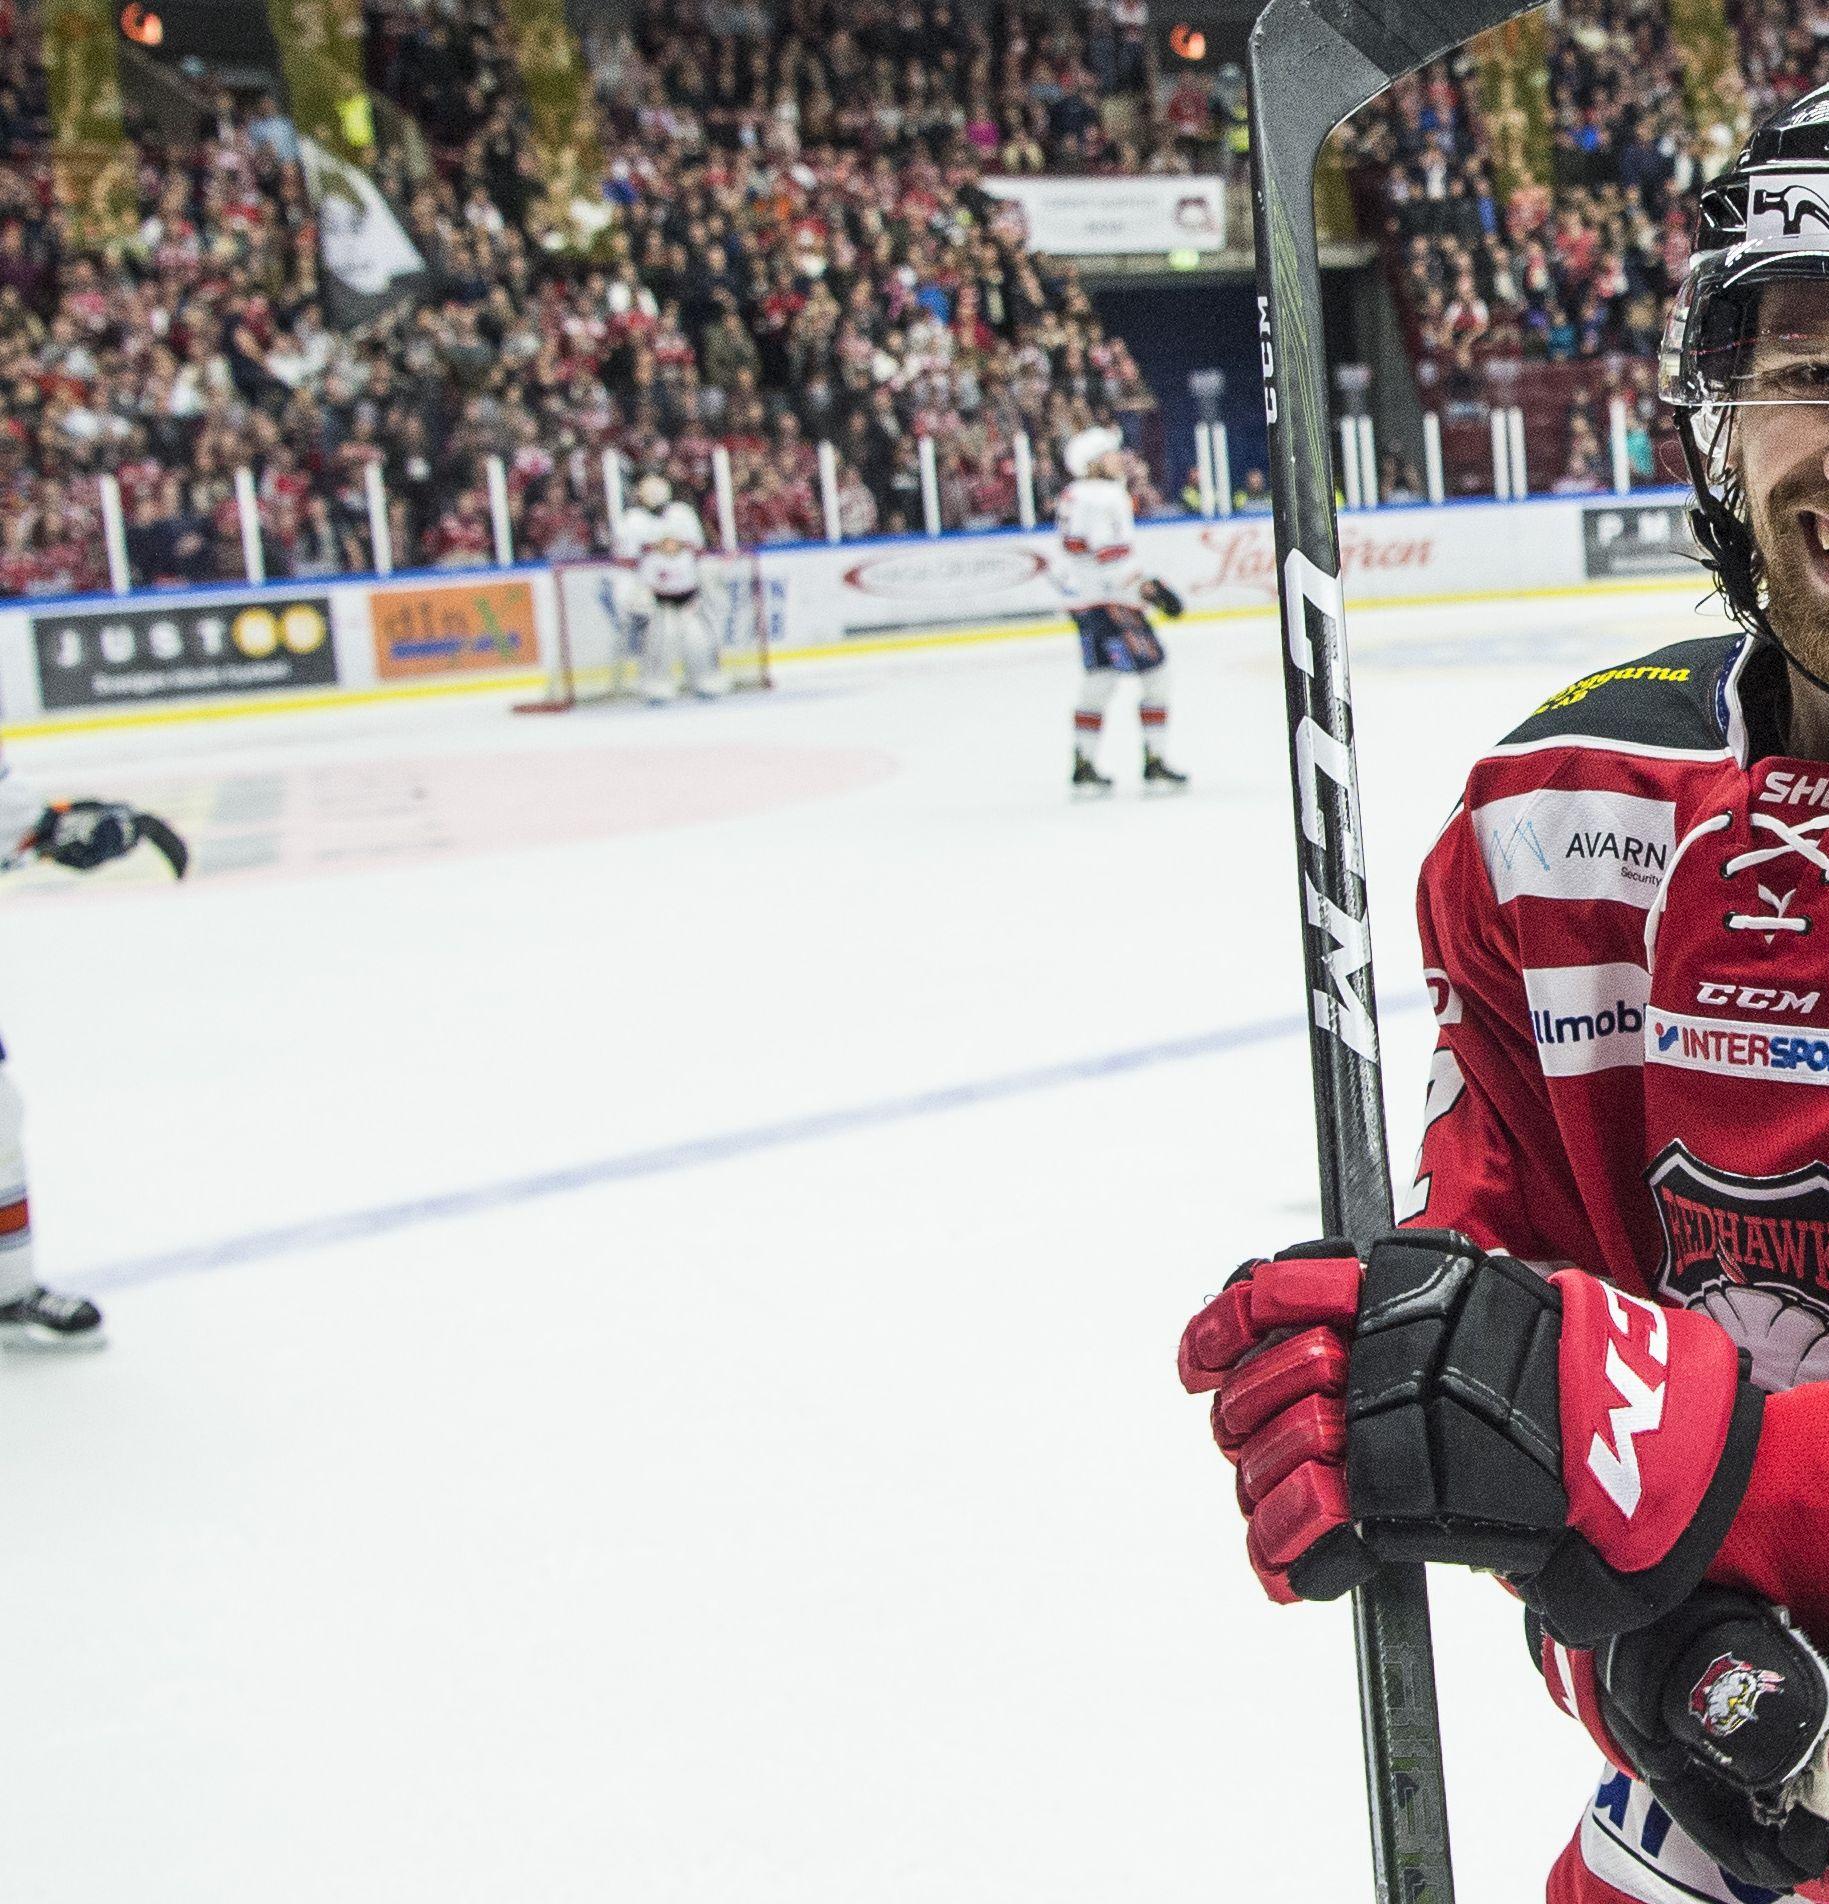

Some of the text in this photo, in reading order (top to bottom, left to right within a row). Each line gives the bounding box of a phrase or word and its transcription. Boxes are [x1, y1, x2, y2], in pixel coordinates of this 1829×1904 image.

[1284, 547, 1379, 1066] CCM
[1565, 831, 1667, 871] AVARN
[1620, 866, 1663, 887] Security
[1696, 980, 1821, 1015] CCM
[1530, 1000, 1648, 1044] llmob
